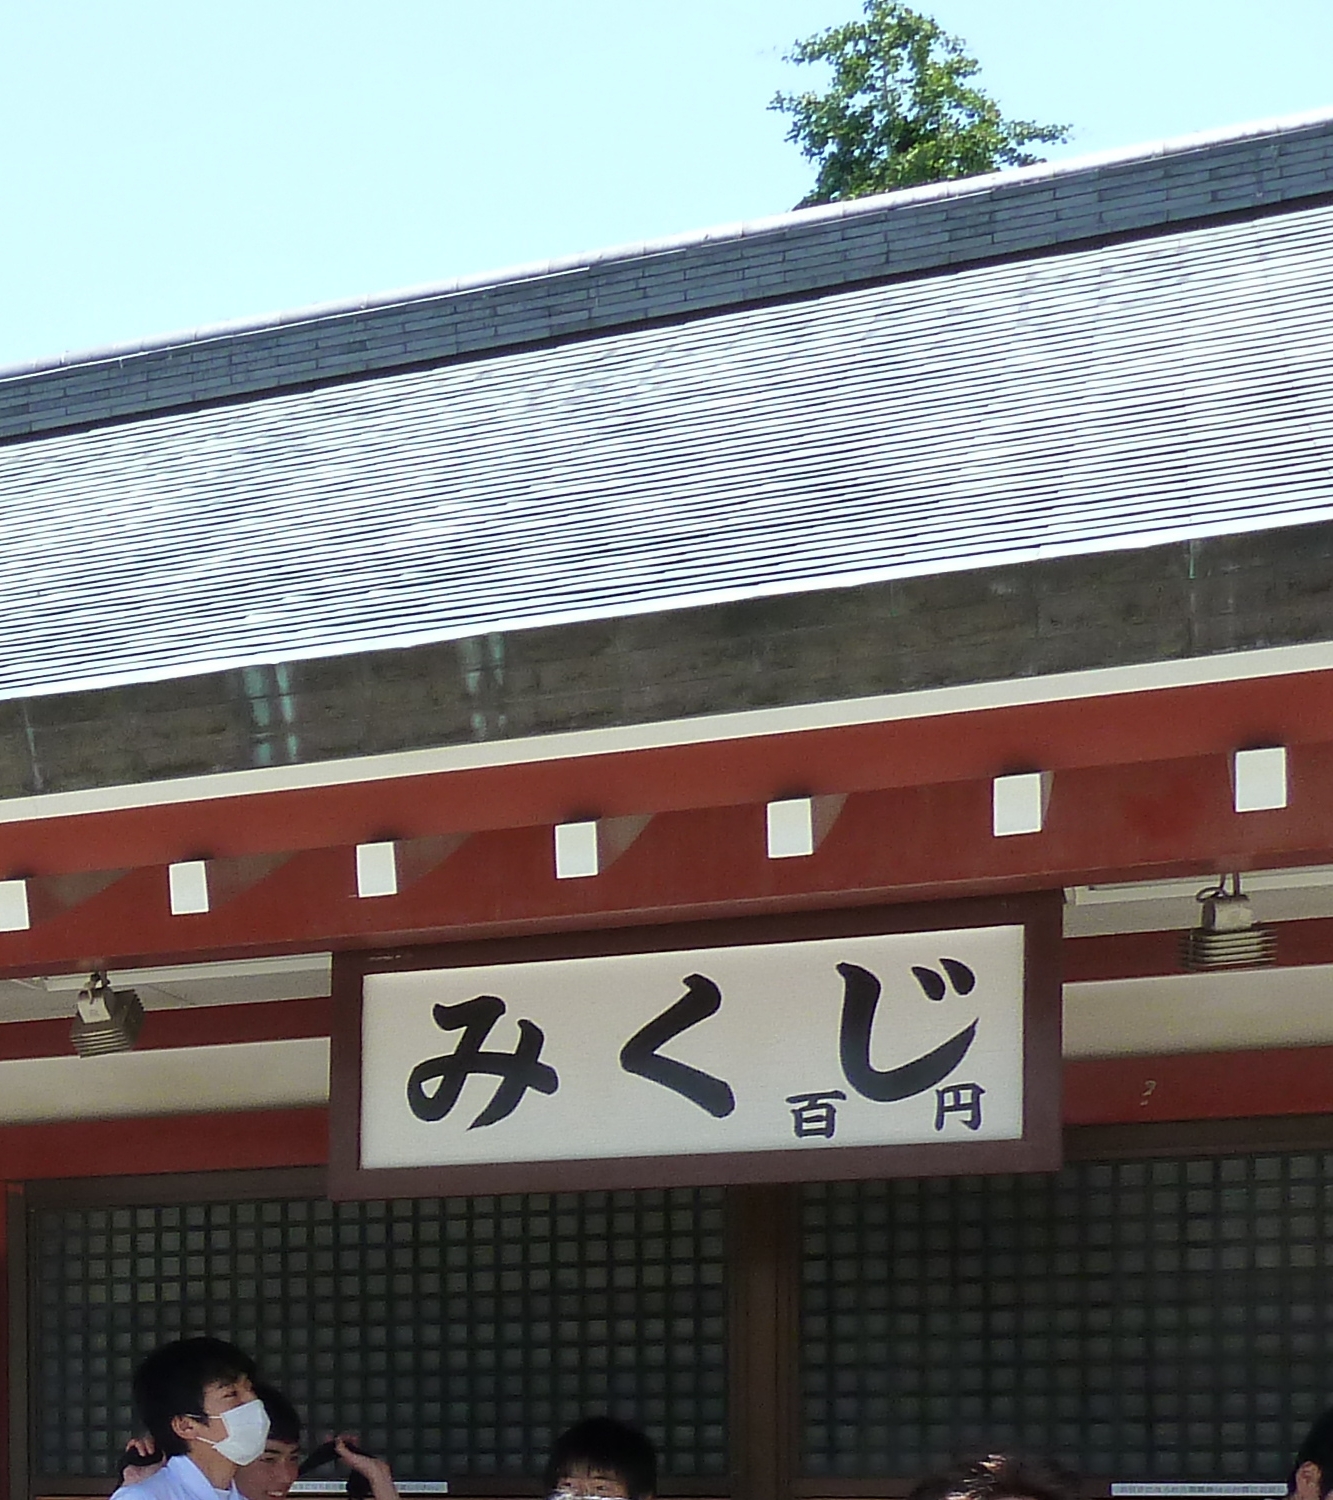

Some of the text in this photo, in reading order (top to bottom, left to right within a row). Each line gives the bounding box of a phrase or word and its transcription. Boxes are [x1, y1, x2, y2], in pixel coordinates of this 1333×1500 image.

[407, 958, 979, 1131] みくじ
[785, 1082, 987, 1139] 百円
